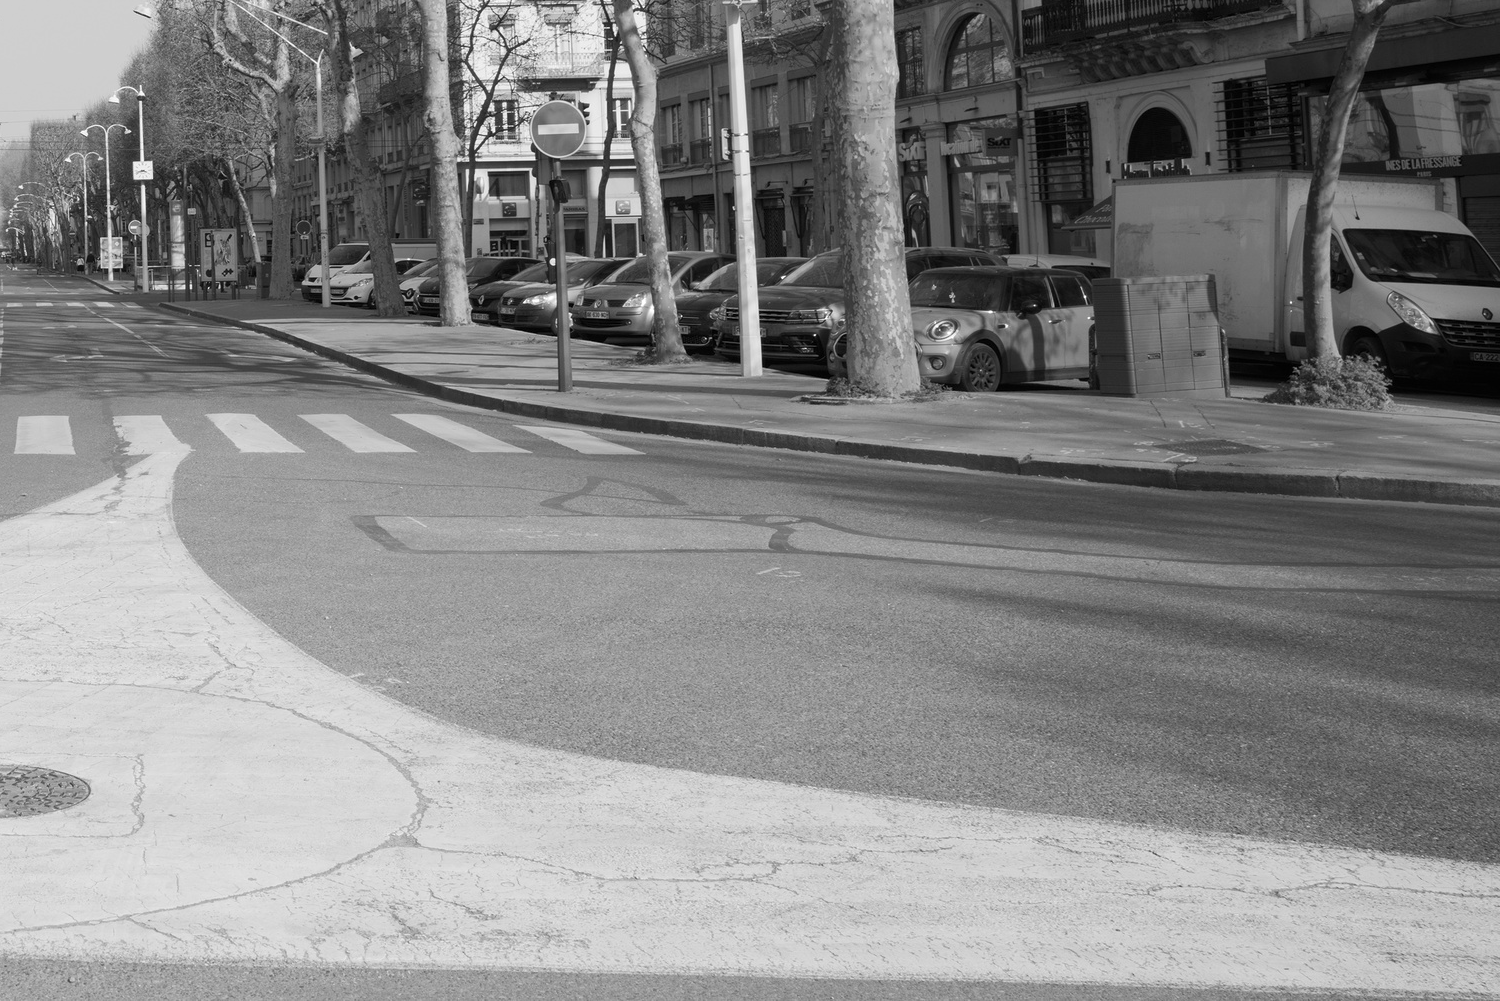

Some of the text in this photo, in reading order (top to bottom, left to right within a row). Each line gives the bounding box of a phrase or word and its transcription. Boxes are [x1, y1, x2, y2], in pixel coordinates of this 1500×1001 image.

[1385, 155, 1462, 171] INES DE LA FRESSANGE
